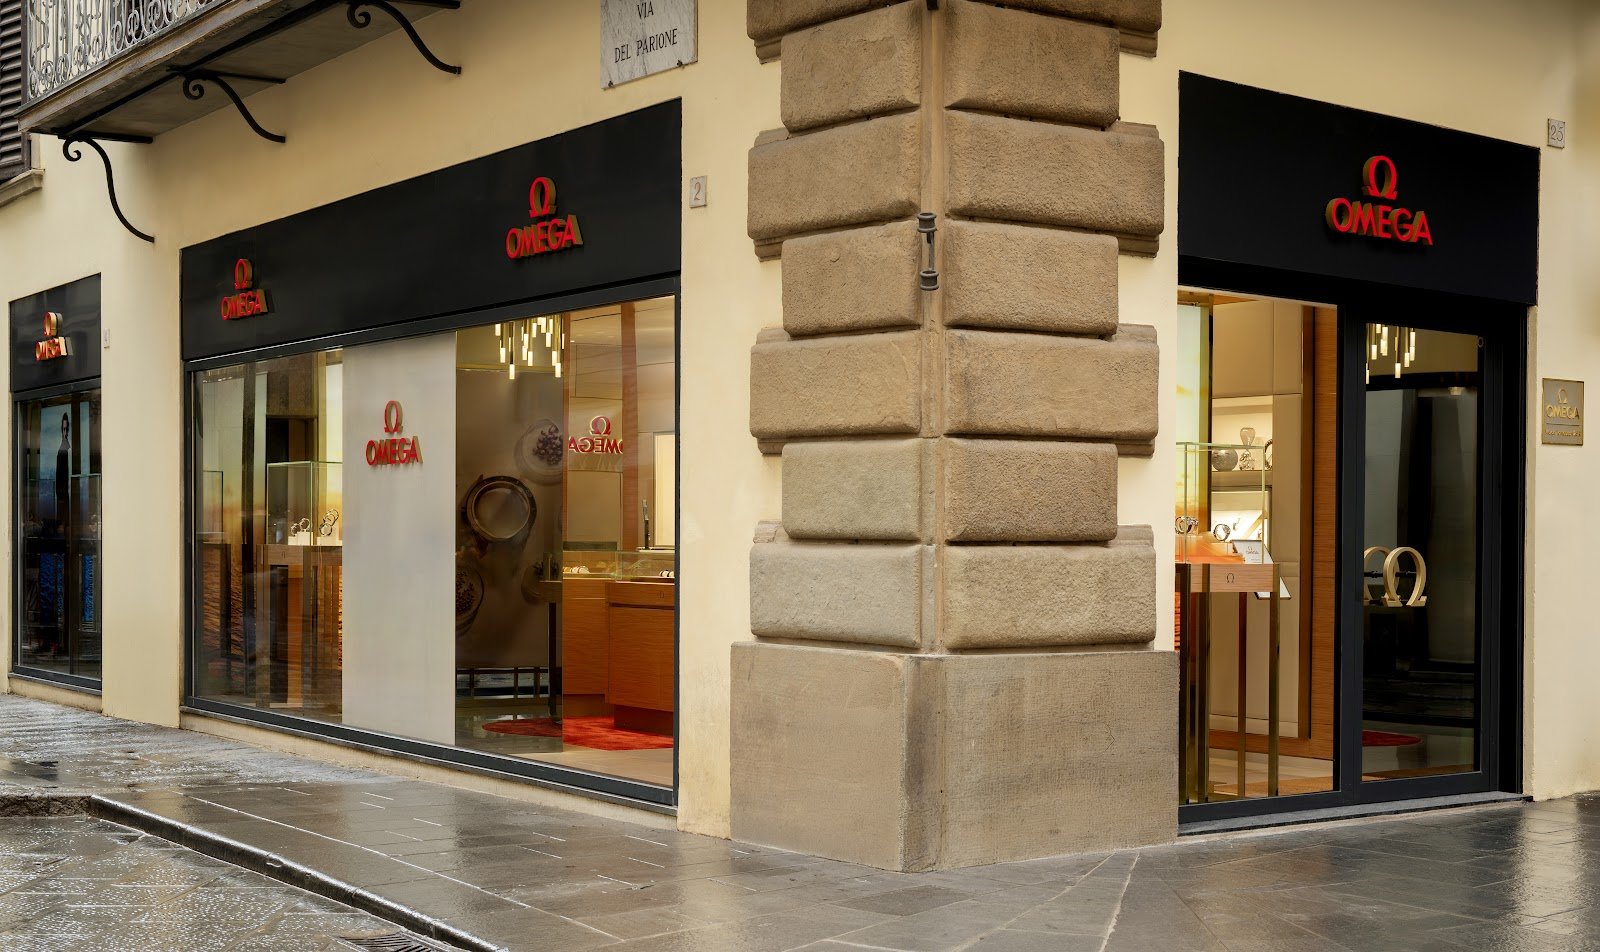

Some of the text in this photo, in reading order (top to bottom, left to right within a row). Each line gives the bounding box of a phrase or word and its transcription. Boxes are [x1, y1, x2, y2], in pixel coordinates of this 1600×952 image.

[636, 1, 654, 19] VIA
[614, 28, 678, 63] DEL PARIONE
[1550, 124, 1564, 141] 25
[694, 182, 701, 201] 2
[505, 214, 584, 259] OMEGA
[1325, 197, 1434, 246] OMEGA
[221, 289, 269, 320] OMEGA
[1546, 405, 1580, 419] OMEGA
[366, 436, 423, 466] OMEGA
